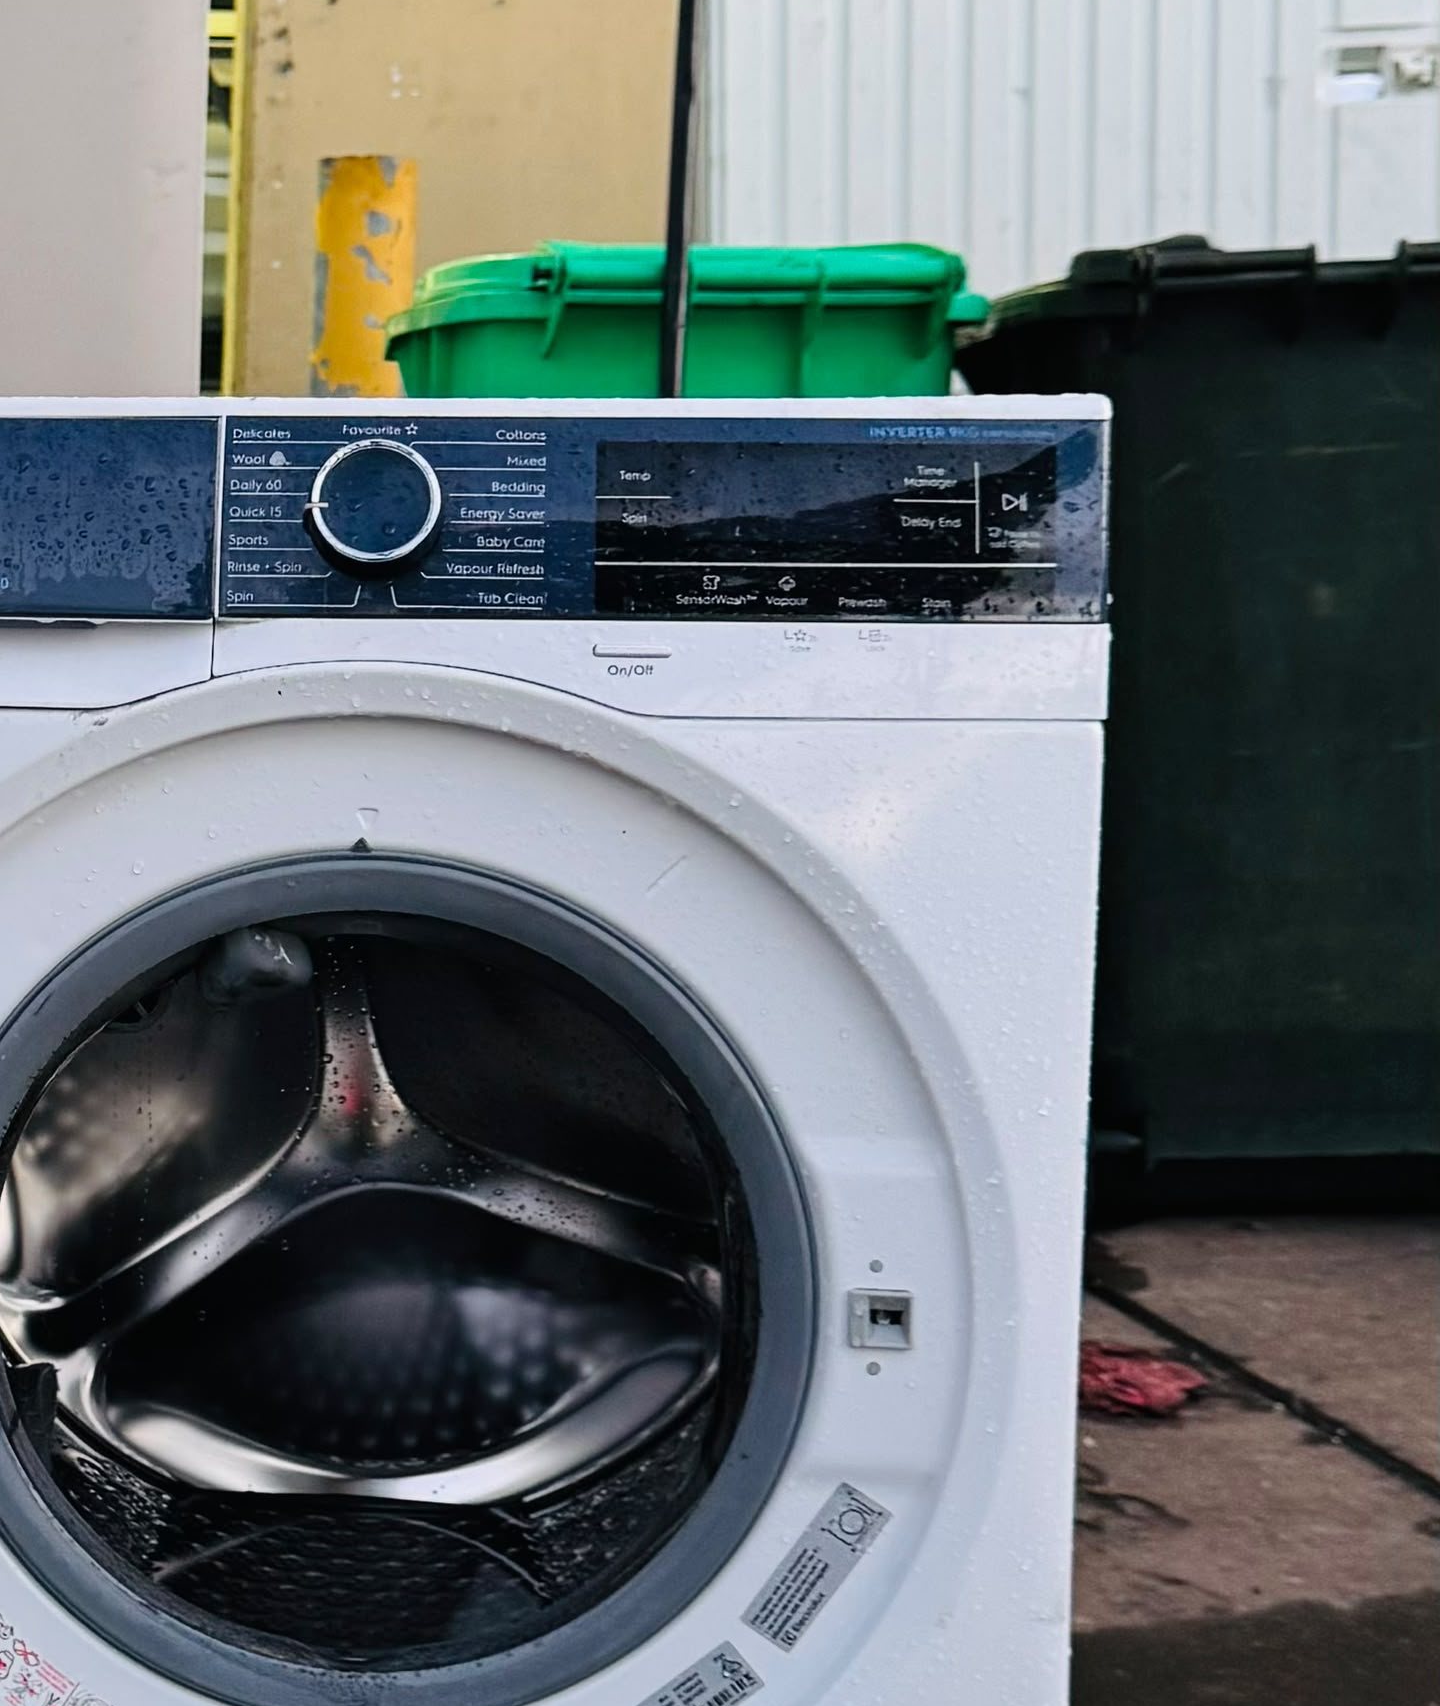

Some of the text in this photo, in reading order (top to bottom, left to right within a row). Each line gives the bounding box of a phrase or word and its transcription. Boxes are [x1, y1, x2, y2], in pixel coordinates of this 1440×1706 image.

[233, 429, 291, 439] Delicates
[342, 424, 401, 435] Favourite
[496, 430, 547, 440] Cottons
[869, 426, 947, 438] INVERTER
[232, 454, 265, 465] Wool
[506, 456, 546, 467] Mixed
[619, 470, 651, 481] Temp
[916, 465, 945, 476] Time
[230, 479, 282, 492] Daily 60
[491, 481, 546, 494] Bedding
[903, 477, 958, 489] Manager
[229, 506, 282, 517] Quick 15
[460, 507, 545, 521] Energy Saver
[621, 512, 647, 524] Spin
[900, 515, 962, 529] Delay End
[228, 534, 269, 545] Sports
[477, 536, 545, 549] Baby Care
[227, 561, 302, 573] Rinse Spin
[446, 563, 544, 575] Vapour Refresh
[227, 590, 254, 602] Spin
[478, 592, 544, 604] Tub Clean
[765, 596, 809, 608] Vapour
[838, 596, 887, 608] Prewash
[921, 597, 952, 609] Stain
[608, 664, 654, 677] On/Off
